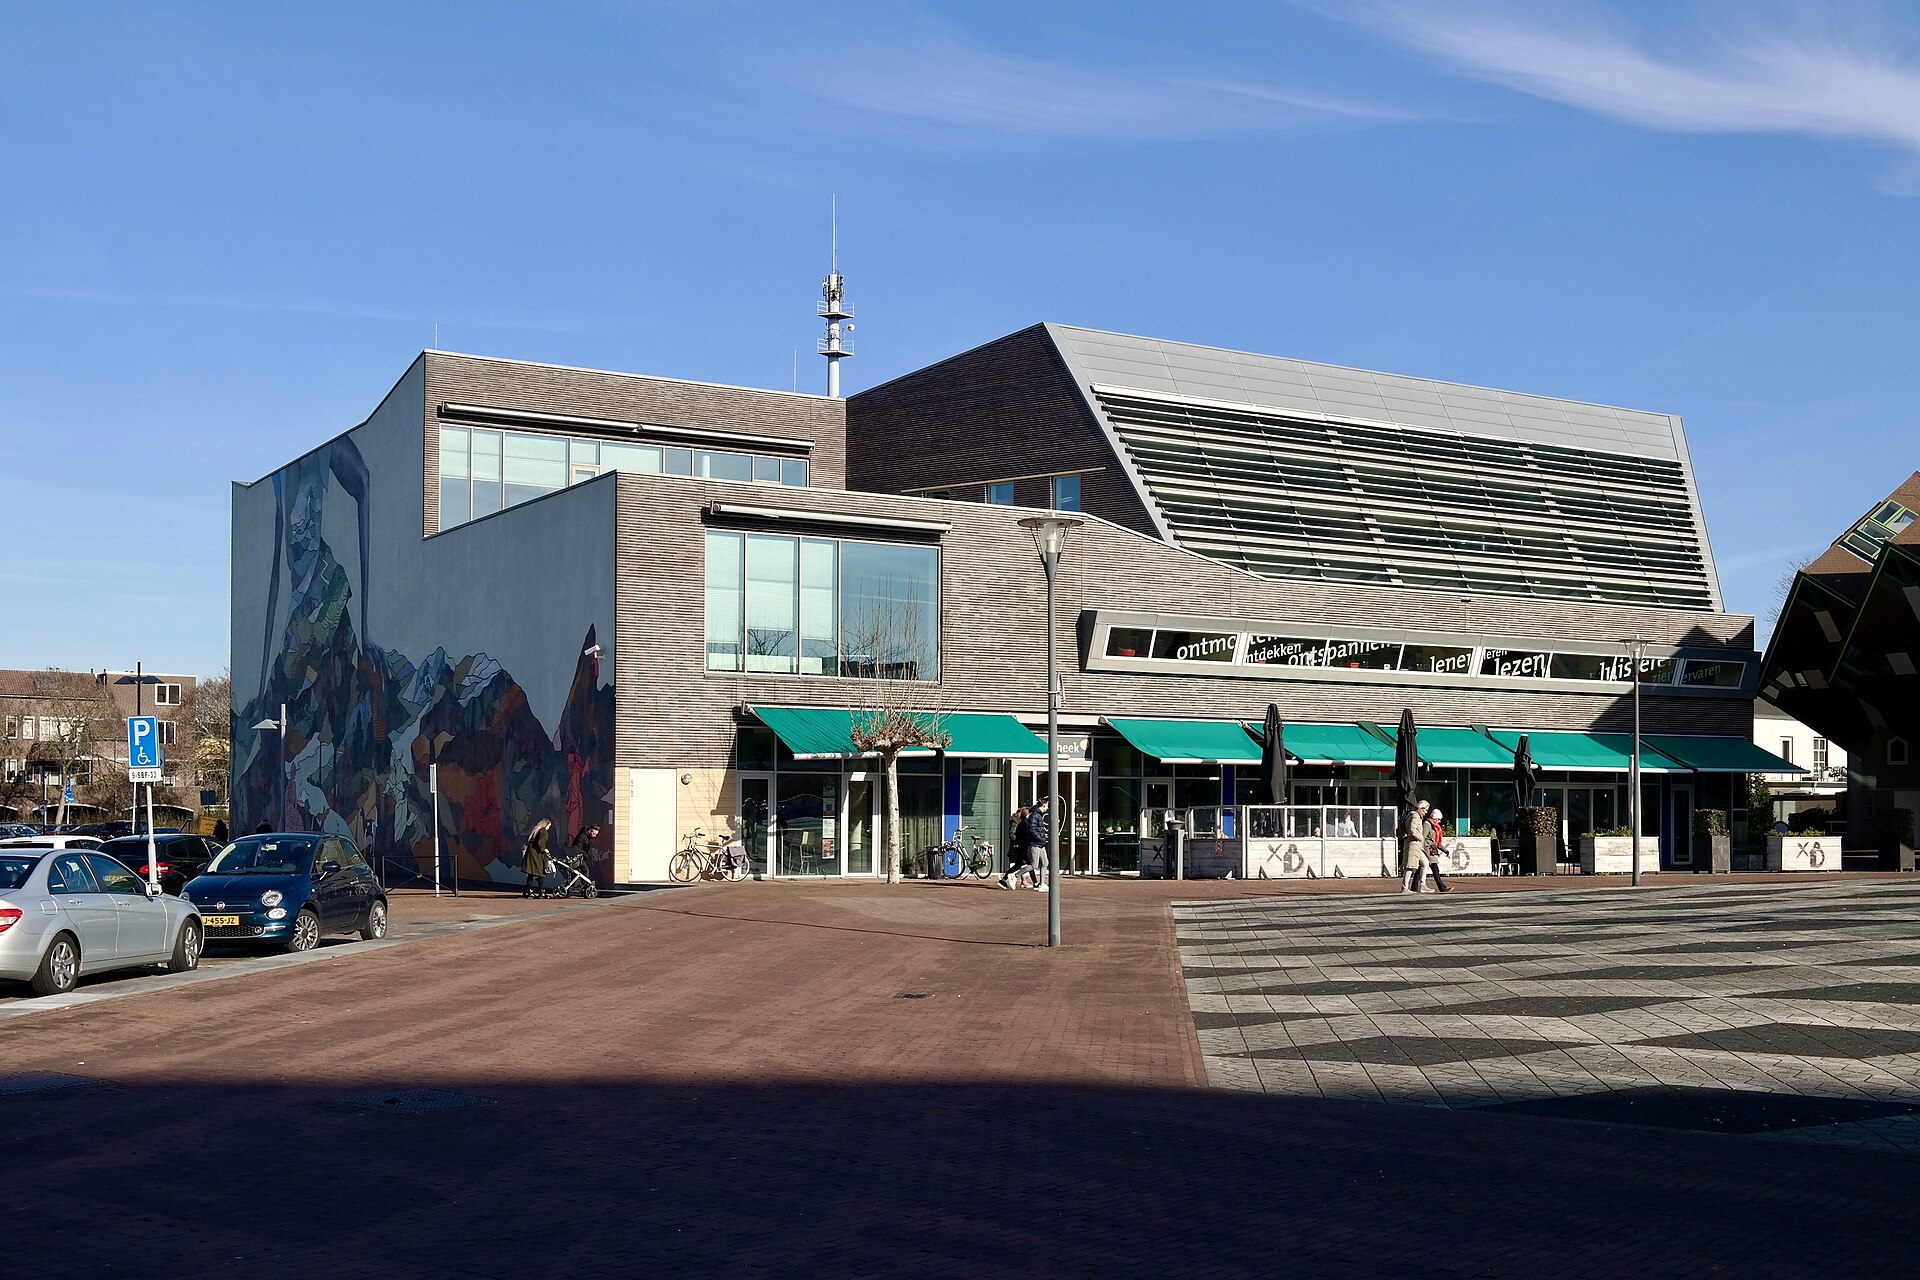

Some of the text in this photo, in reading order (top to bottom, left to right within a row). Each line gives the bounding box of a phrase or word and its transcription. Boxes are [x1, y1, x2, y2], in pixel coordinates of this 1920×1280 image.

[1245, 643, 1301, 662] ntdekken
[1494, 653, 1545, 676] lezen
[134, 720, 150, 745] P
